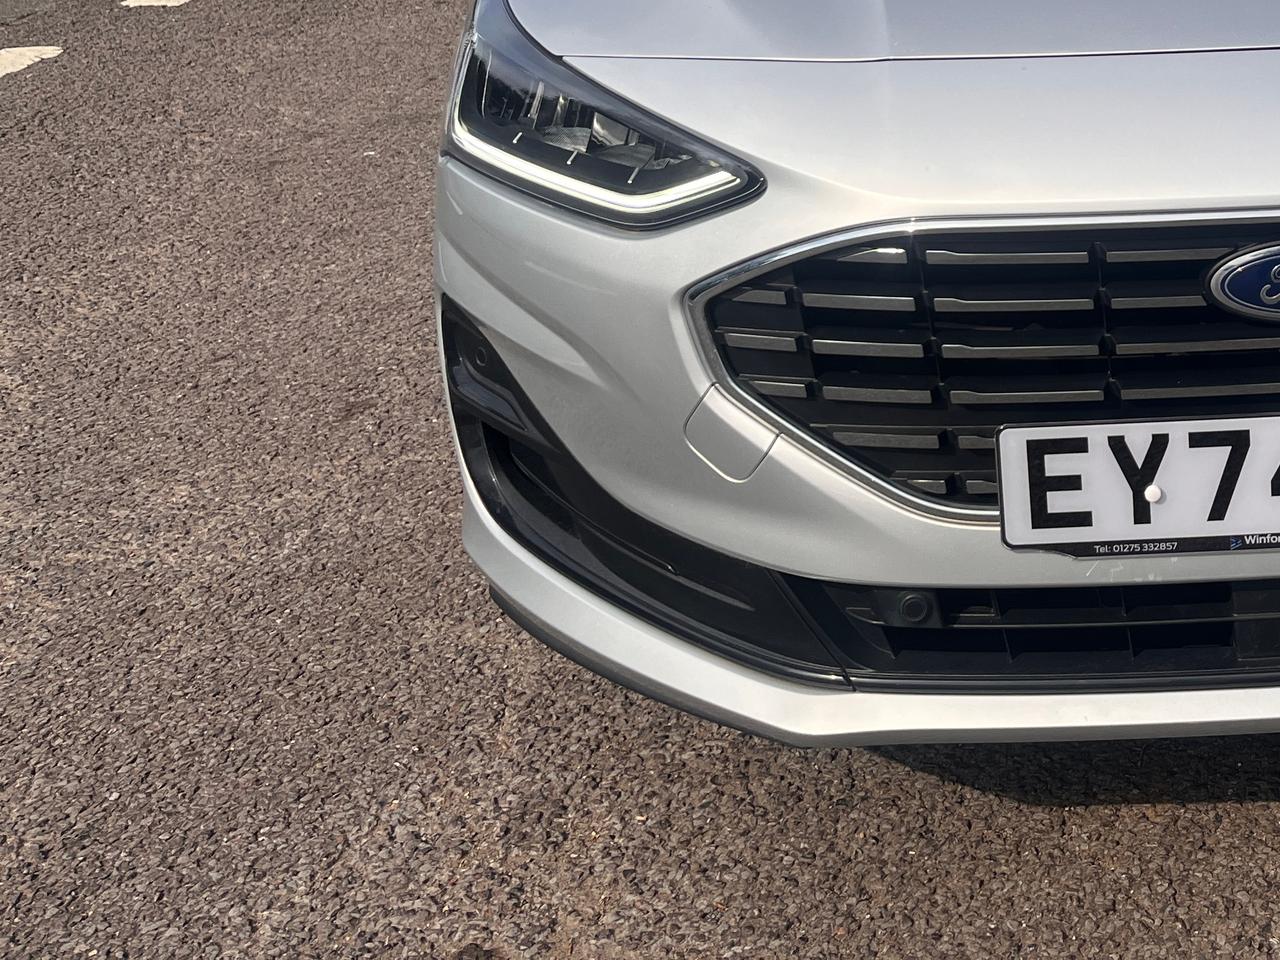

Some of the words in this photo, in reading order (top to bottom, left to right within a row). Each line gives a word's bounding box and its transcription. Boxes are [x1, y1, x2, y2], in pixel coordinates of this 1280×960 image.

[1094, 545, 1111, 553] Tel:
[1113, 544, 1140, 552] 01275
[1142, 542, 1178, 551] 332857
